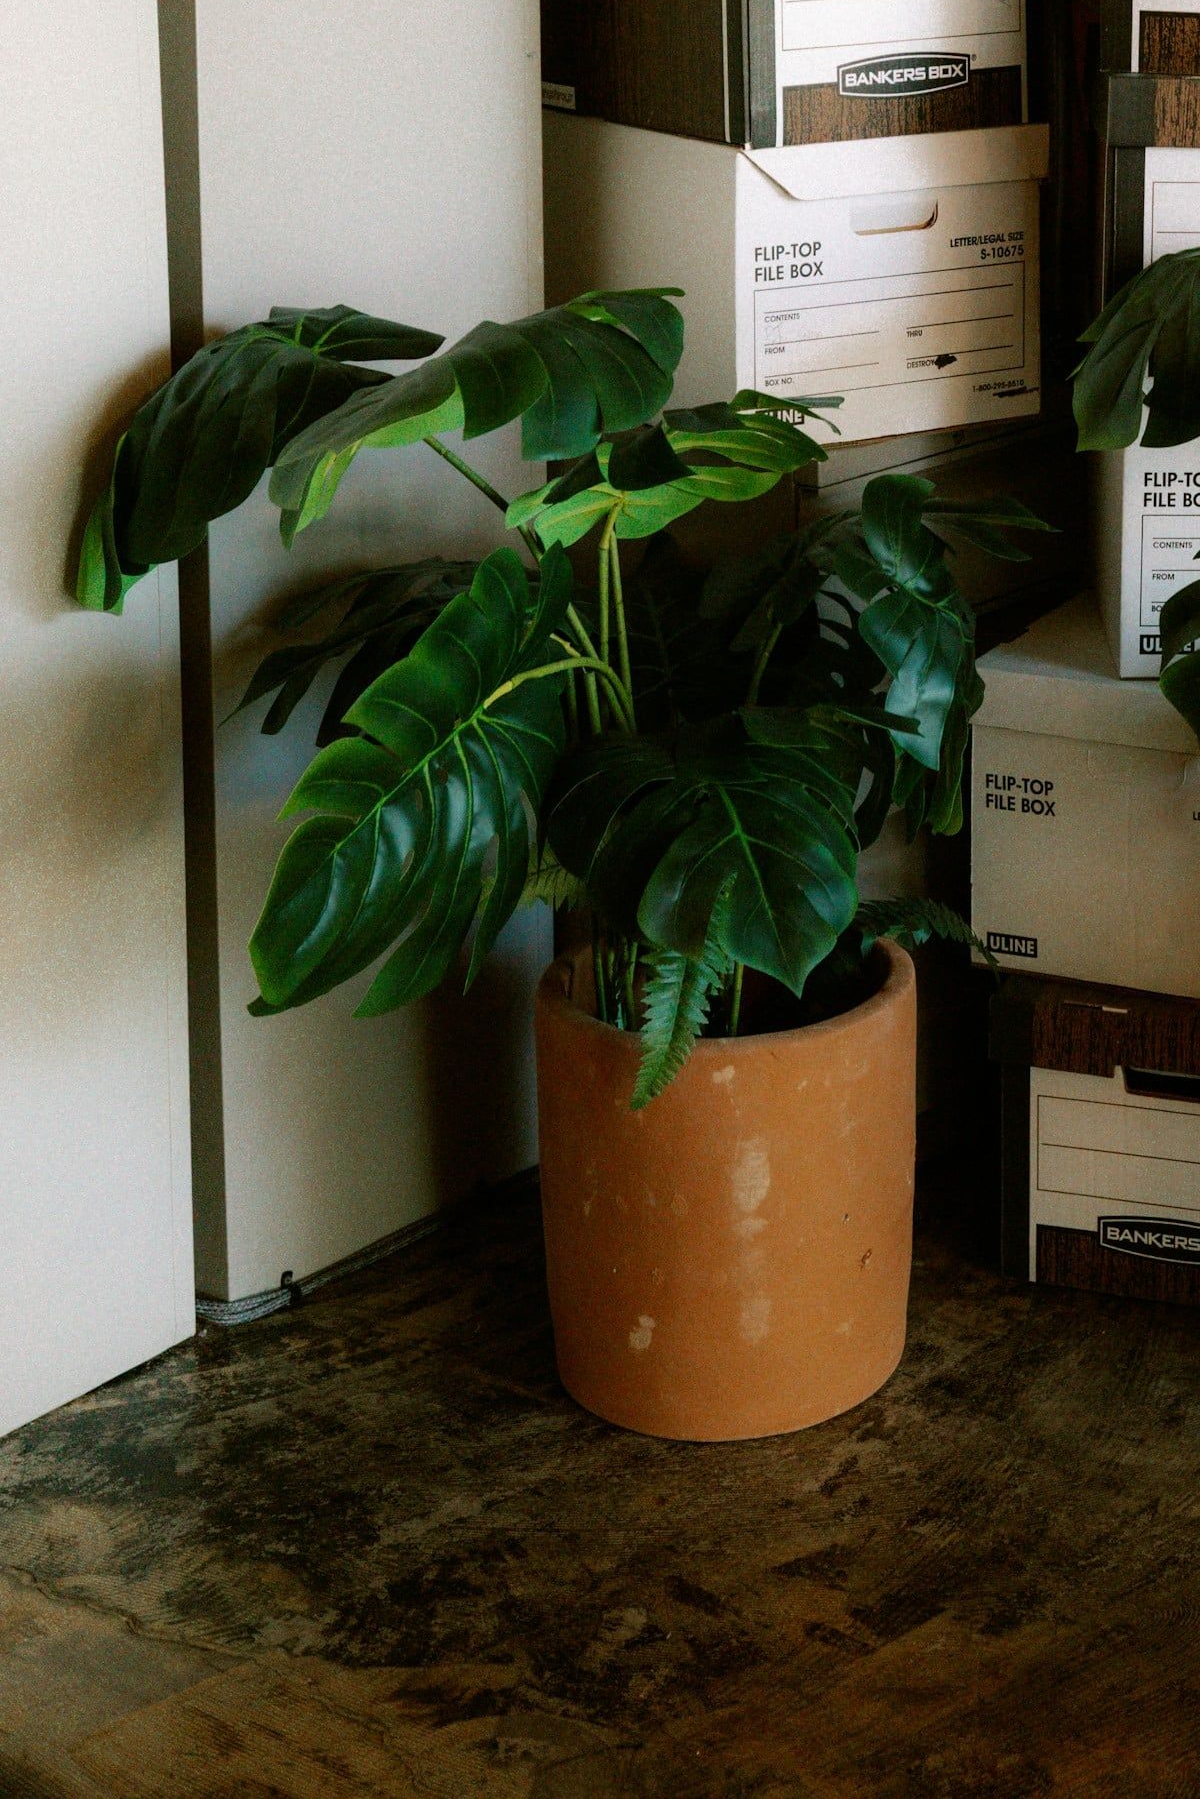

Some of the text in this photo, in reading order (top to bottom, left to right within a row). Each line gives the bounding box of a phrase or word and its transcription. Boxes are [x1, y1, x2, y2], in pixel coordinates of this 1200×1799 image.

[845, 63, 965, 88] BANKERS BOX
[950, 231, 1024, 248] LETTER/LEGAL SIZE
[755, 241, 822, 262] FLIP-TOP
[981, 245, 1025, 260] S-10675
[755, 261, 824, 282] FILE BOX
[764, 313, 800, 323] CONTENTS
[907, 330, 923, 338] THRU
[764, 346, 786, 355] FROM
[764, 378, 779, 387] BOX
[1143, 492, 1176, 507] FILE
[1152, 541, 1193, 549] CONTENTS
[985, 773, 1054, 796] FLIP-TOP
[986, 793, 1056, 817] FILE BOX
[989, 935, 1035, 955] ULINE
[1106, 1226, 1200, 1252] BANKERS
